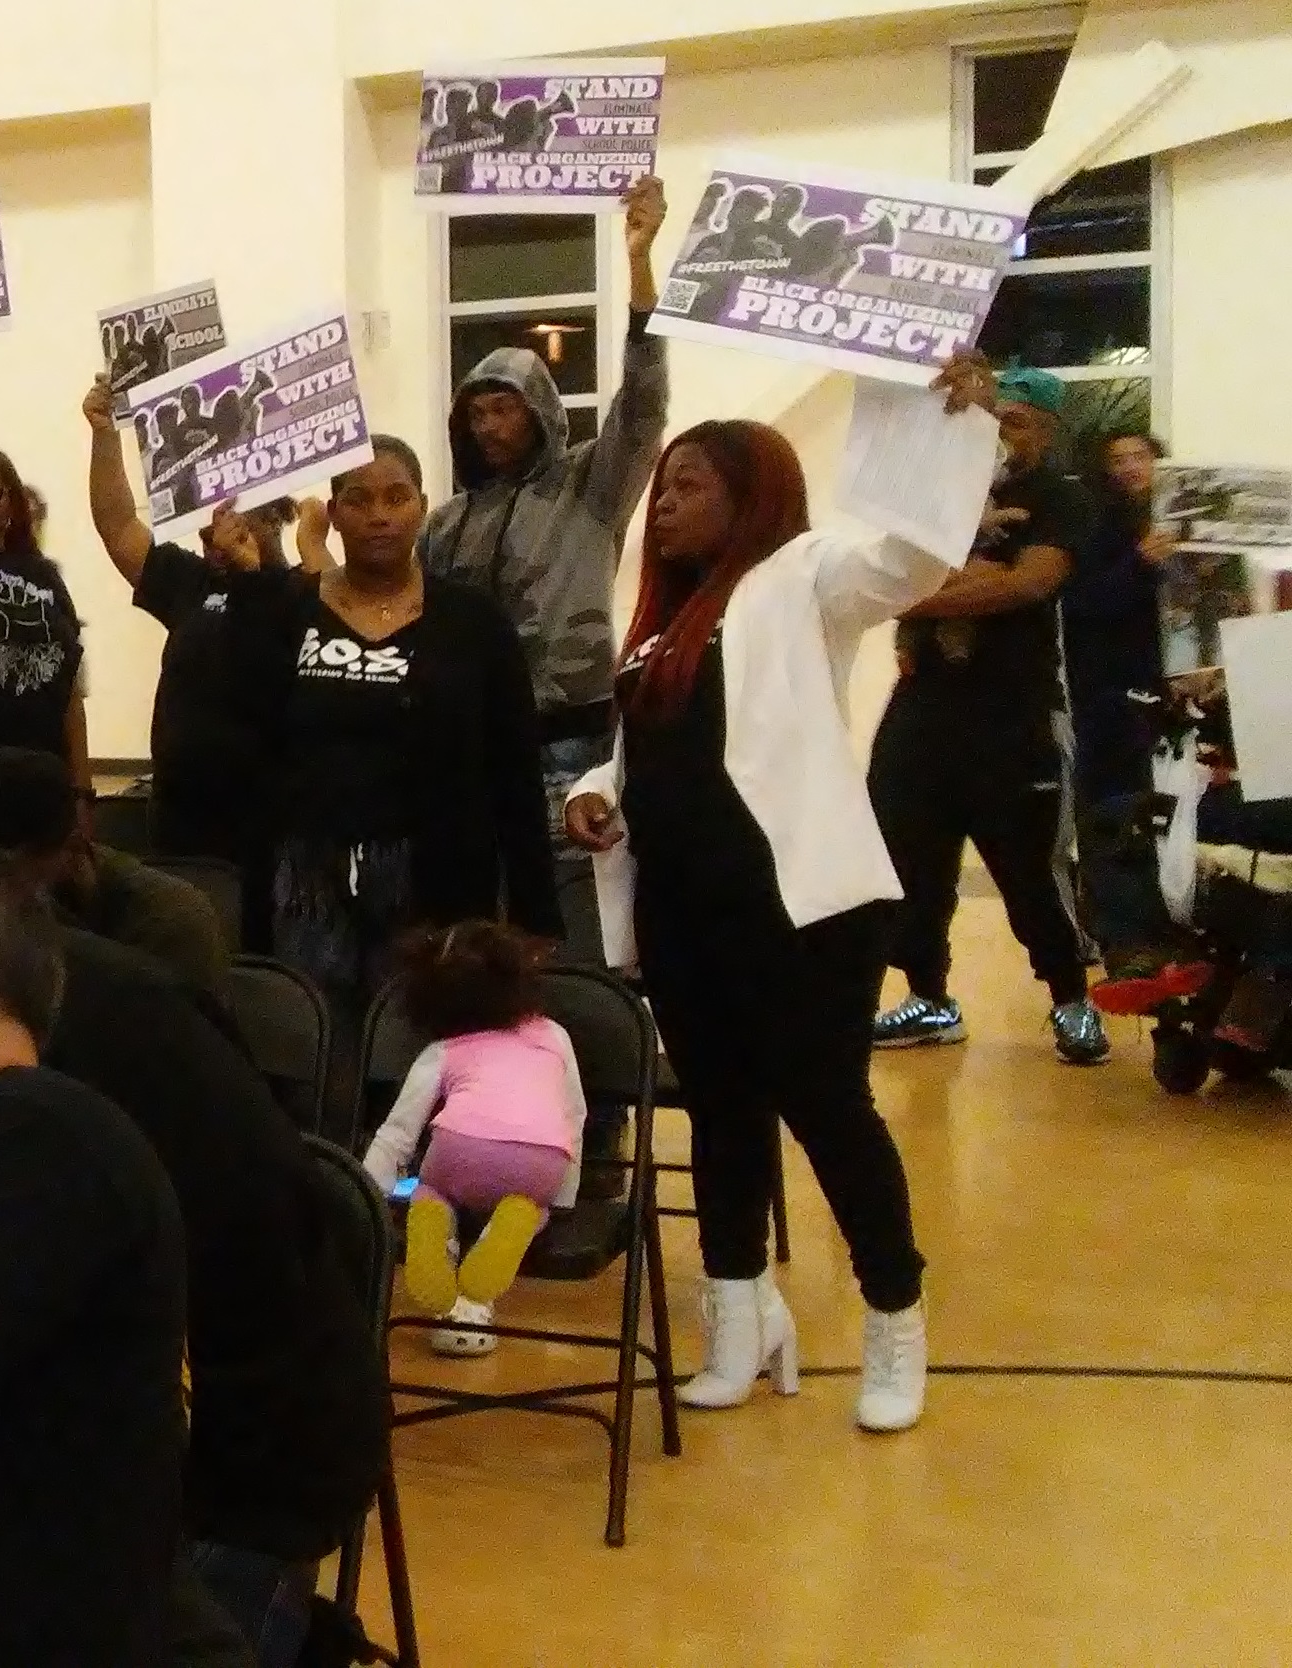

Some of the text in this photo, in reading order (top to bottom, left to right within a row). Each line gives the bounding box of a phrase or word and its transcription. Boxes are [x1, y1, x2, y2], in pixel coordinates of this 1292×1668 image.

[544, 77, 658, 99] STAND
[575, 117, 656, 135] WITH
[472, 152, 651, 165] BLACK ORGANIZING
[472, 165, 650, 189] PROJECT
[859, 199, 1013, 243] STAND
[890, 252, 997, 292] WITH
[143, 290, 216, 323] ELIMINATE
[741, 276, 822, 303] BLACK
[823, 288, 974, 330] ORGANIZING
[167, 325, 224, 350] SCHOOL
[728, 291, 971, 358] PROJECT
[240, 321, 343, 384] STAND
[276, 360, 353, 406] WITH
[195, 443, 249, 475] BLACK
[252, 399, 358, 450] ORGANIZING
[198, 413, 360, 500] PROJECT
